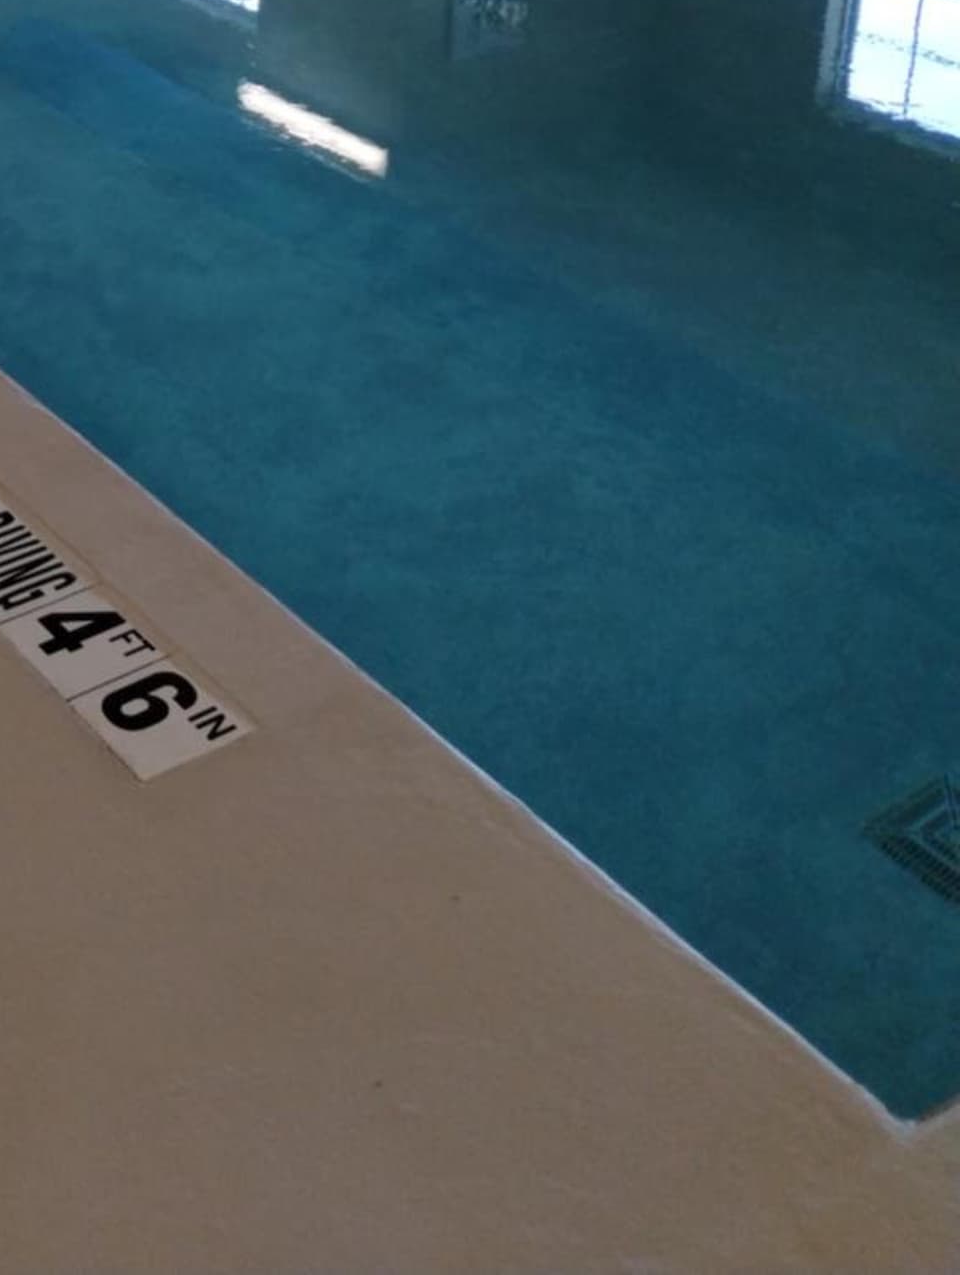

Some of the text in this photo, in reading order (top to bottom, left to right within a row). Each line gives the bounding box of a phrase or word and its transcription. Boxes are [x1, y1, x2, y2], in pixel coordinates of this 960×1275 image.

[37, 610, 127, 655] 4
[109, 629, 156, 658] FT
[101, 671, 199, 732] 6
[188, 706, 237, 741] IN
